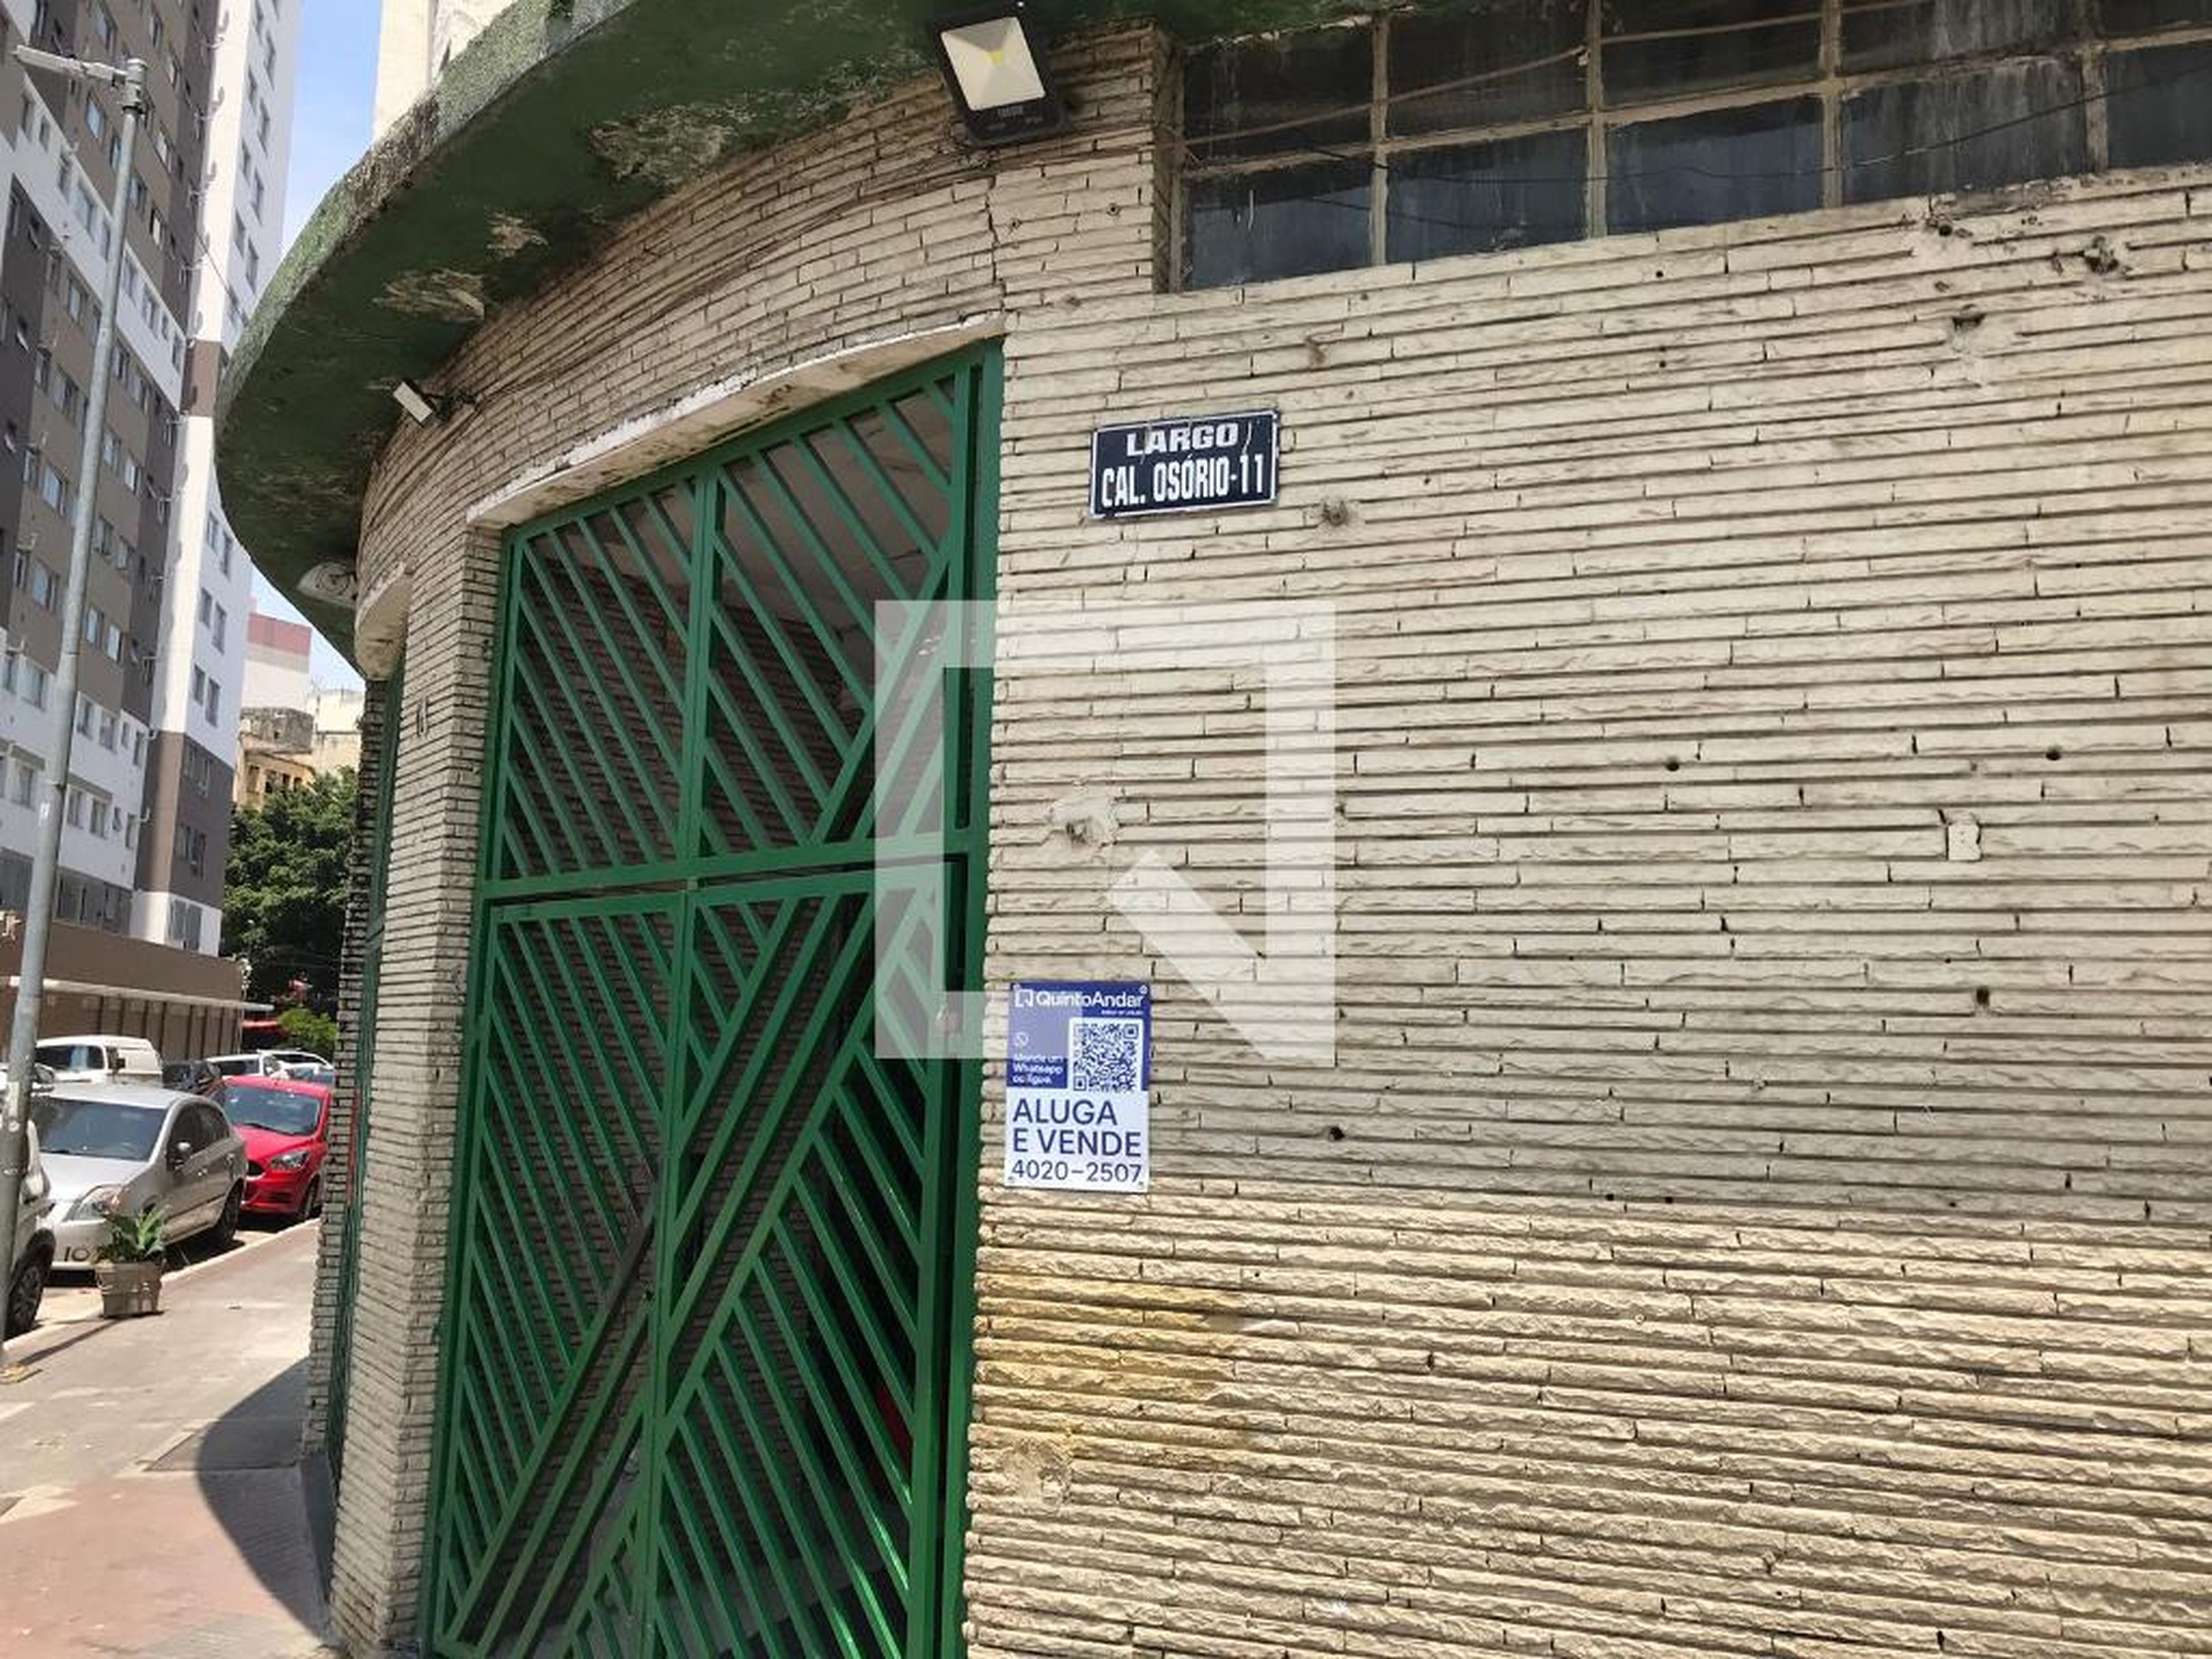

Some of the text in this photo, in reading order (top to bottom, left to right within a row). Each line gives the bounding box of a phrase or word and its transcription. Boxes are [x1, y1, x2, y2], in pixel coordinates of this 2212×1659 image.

[1127, 423, 1238, 456] LARGO
[1101, 465, 1146, 507] CAL.
[1036, 990, 1145, 1007] QuintoAndar
[1013, 1098, 1118, 1126] ALUGA
[1013, 1127, 1141, 1157] E VENDE
[1012, 1159, 1142, 1183] 4020-2507
